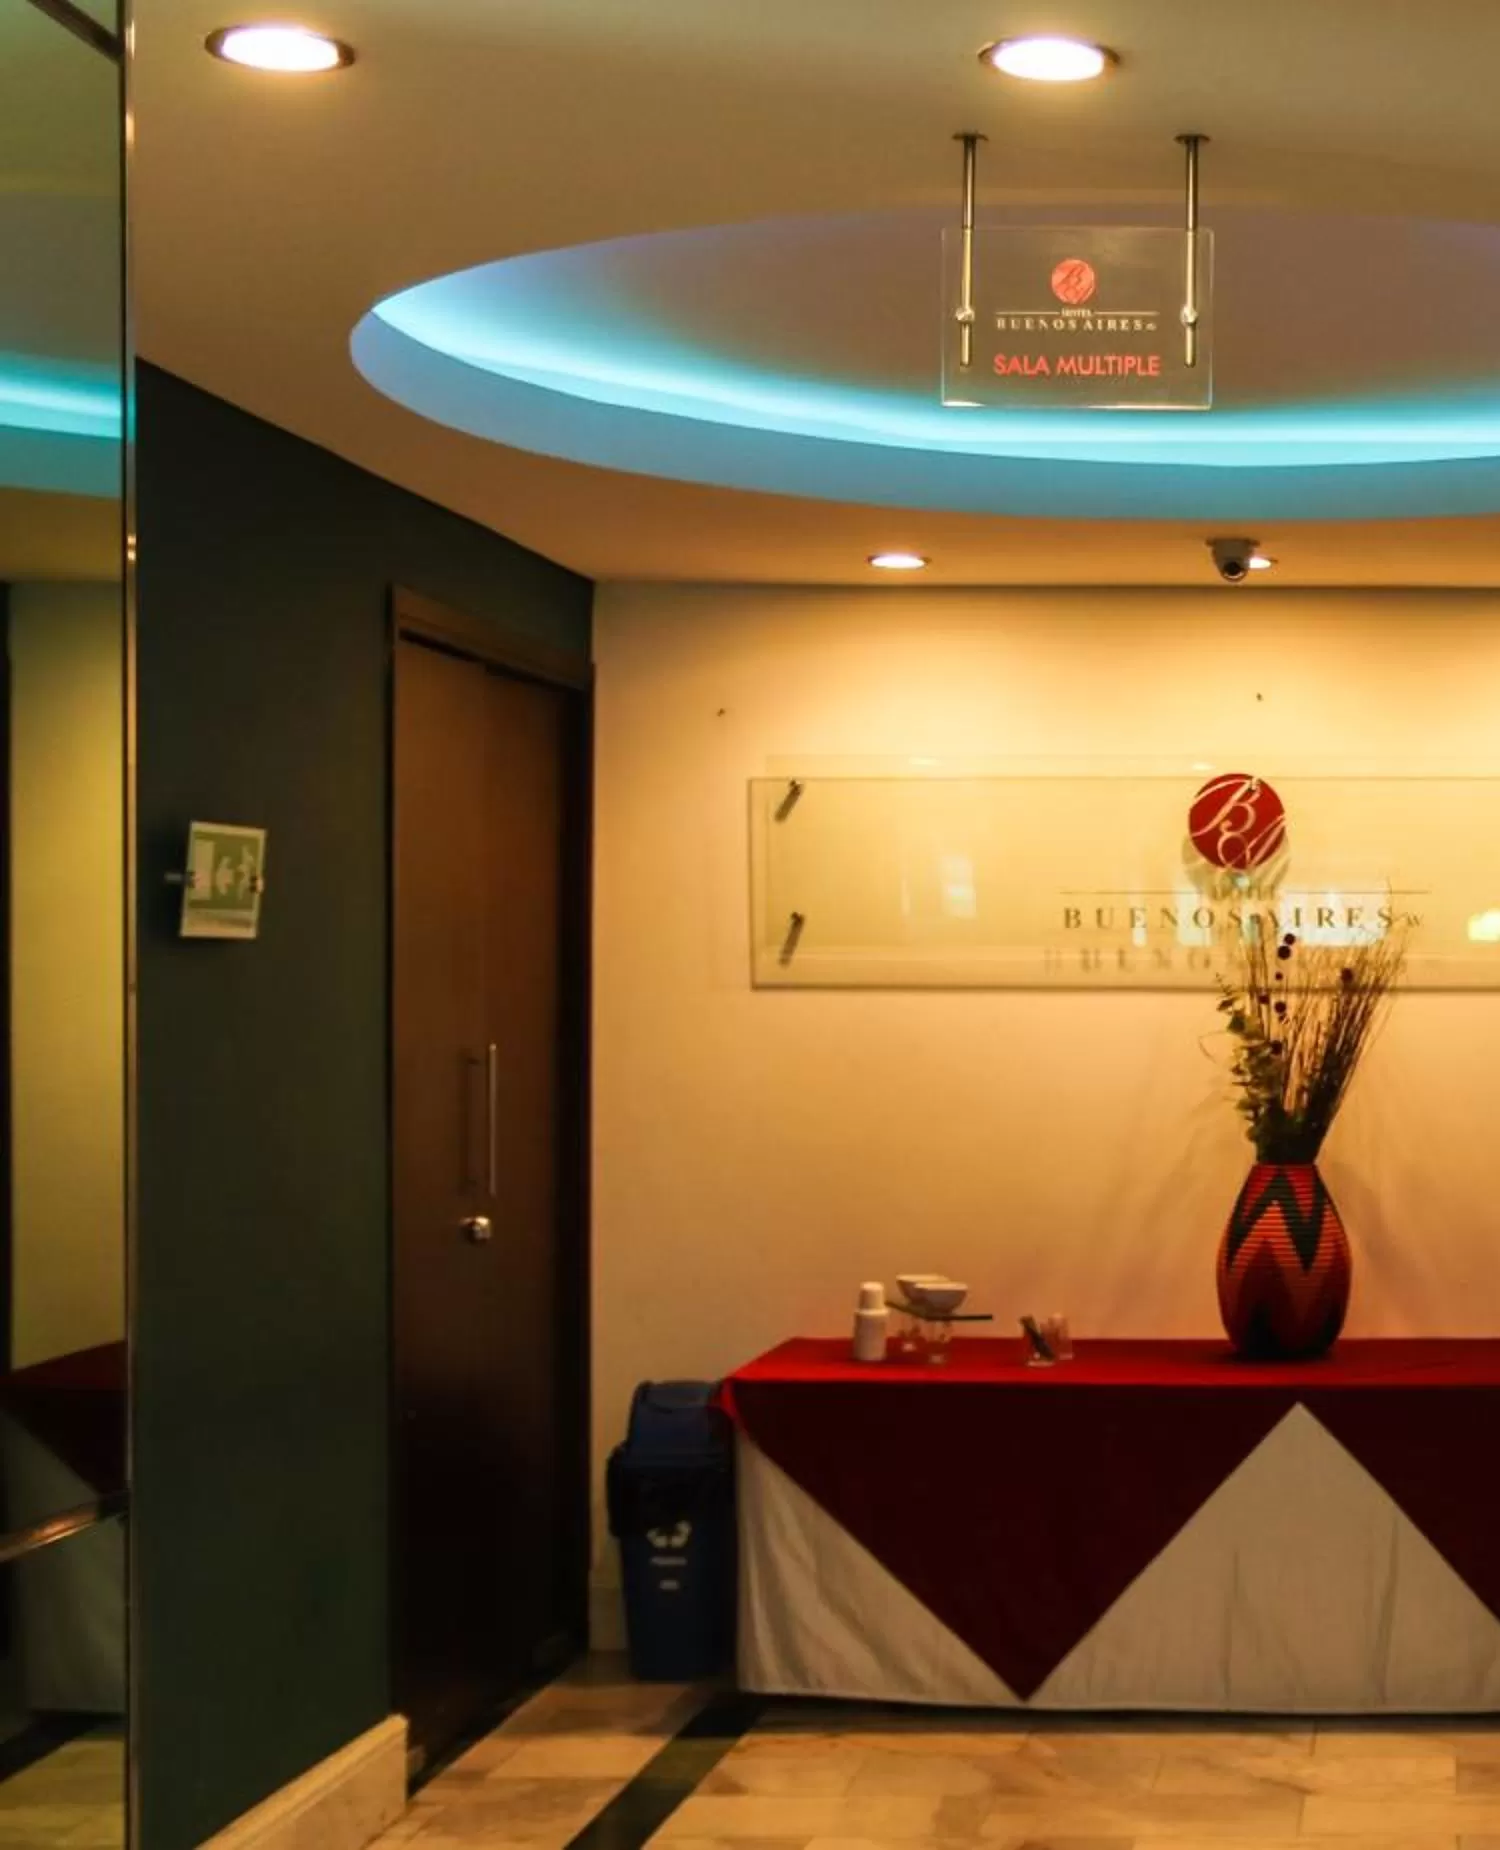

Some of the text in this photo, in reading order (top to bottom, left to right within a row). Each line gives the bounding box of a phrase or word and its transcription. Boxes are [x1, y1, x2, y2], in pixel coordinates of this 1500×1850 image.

[996, 318, 1077, 331] BUENOS
[1083, 318, 1142, 331] AIRES
[994, 354, 1161, 376] SALA MULTIPLE
[1063, 906, 1243, 930] BUENOS
